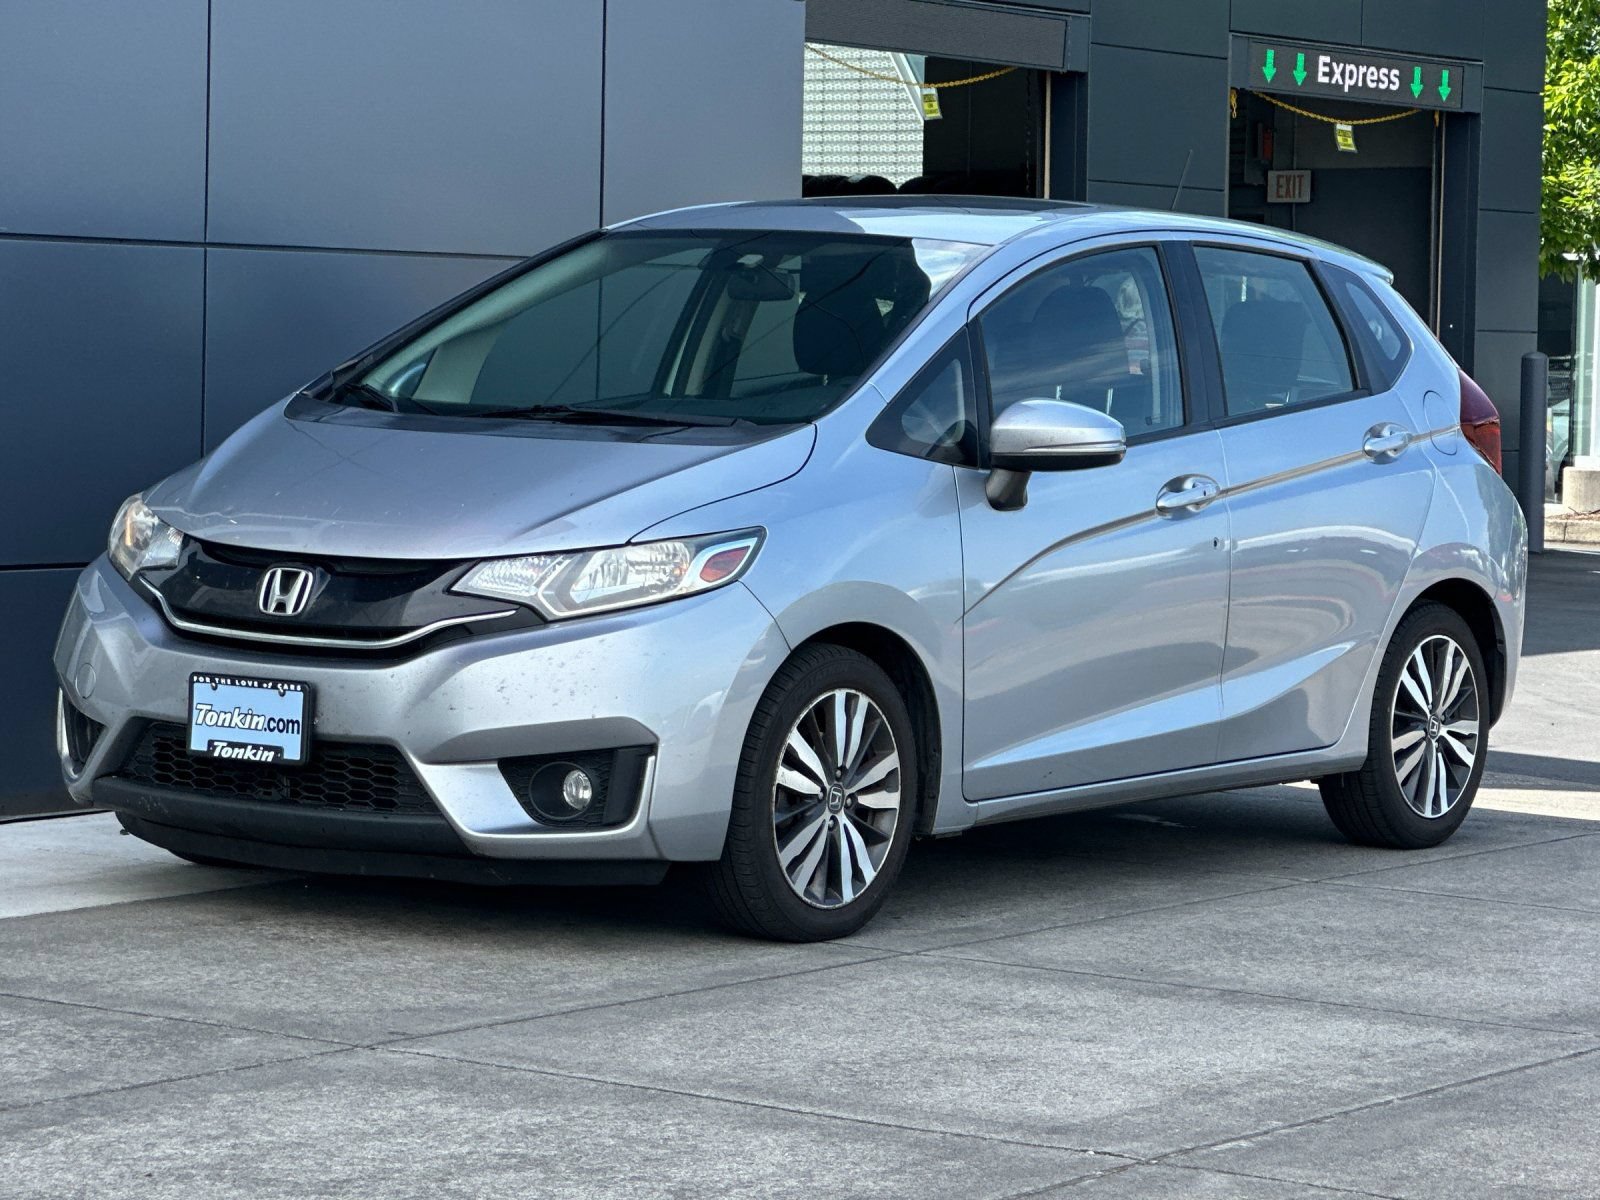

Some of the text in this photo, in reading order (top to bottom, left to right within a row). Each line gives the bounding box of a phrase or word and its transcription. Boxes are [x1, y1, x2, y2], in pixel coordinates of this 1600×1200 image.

[1317, 55, 1400, 92] Express
[1275, 174, 1304, 199] EXIT
[214, 677, 231, 685] THE
[235, 679, 258, 687] LOVE
[277, 683, 302, 691] CARS
[195, 702, 300, 735] Tonkin.com
[213, 741, 275, 762] Tonkin
